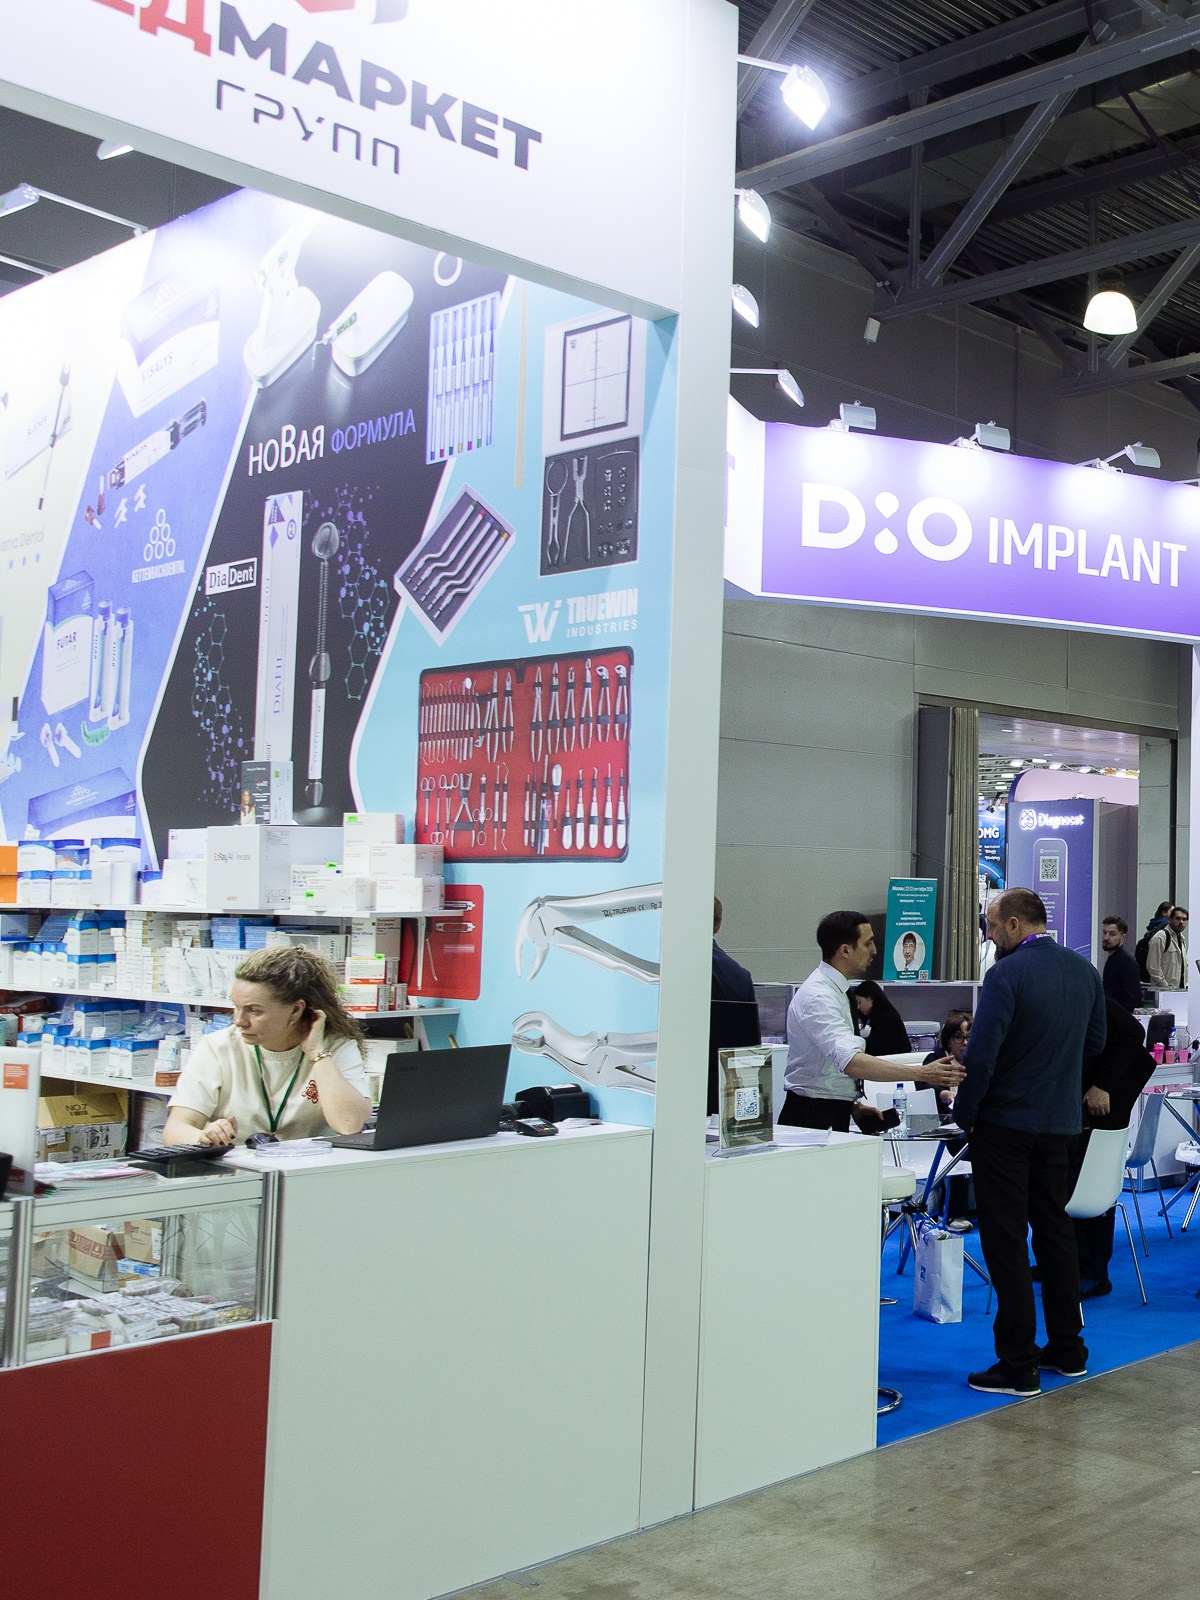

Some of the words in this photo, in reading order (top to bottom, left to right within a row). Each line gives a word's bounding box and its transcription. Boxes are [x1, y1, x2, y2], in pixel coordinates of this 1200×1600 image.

[92, 0, 543, 170] ДМАРКЕТ
[216, 79, 401, 175] ГРУПП
[248, 424, 324, 477] НОВАЯ
[331, 408, 417, 453] ФОРМУЛА
[988, 518, 1188, 587] IMPLANT
[209, 563, 254, 591] DiaDent
[566, 588, 639, 621] TRUEWIN
[56, 632, 77, 649] FUTAR
[566, 618, 638, 638] INDUSTRIES
[613, 905, 636, 915] TRUEWIN
